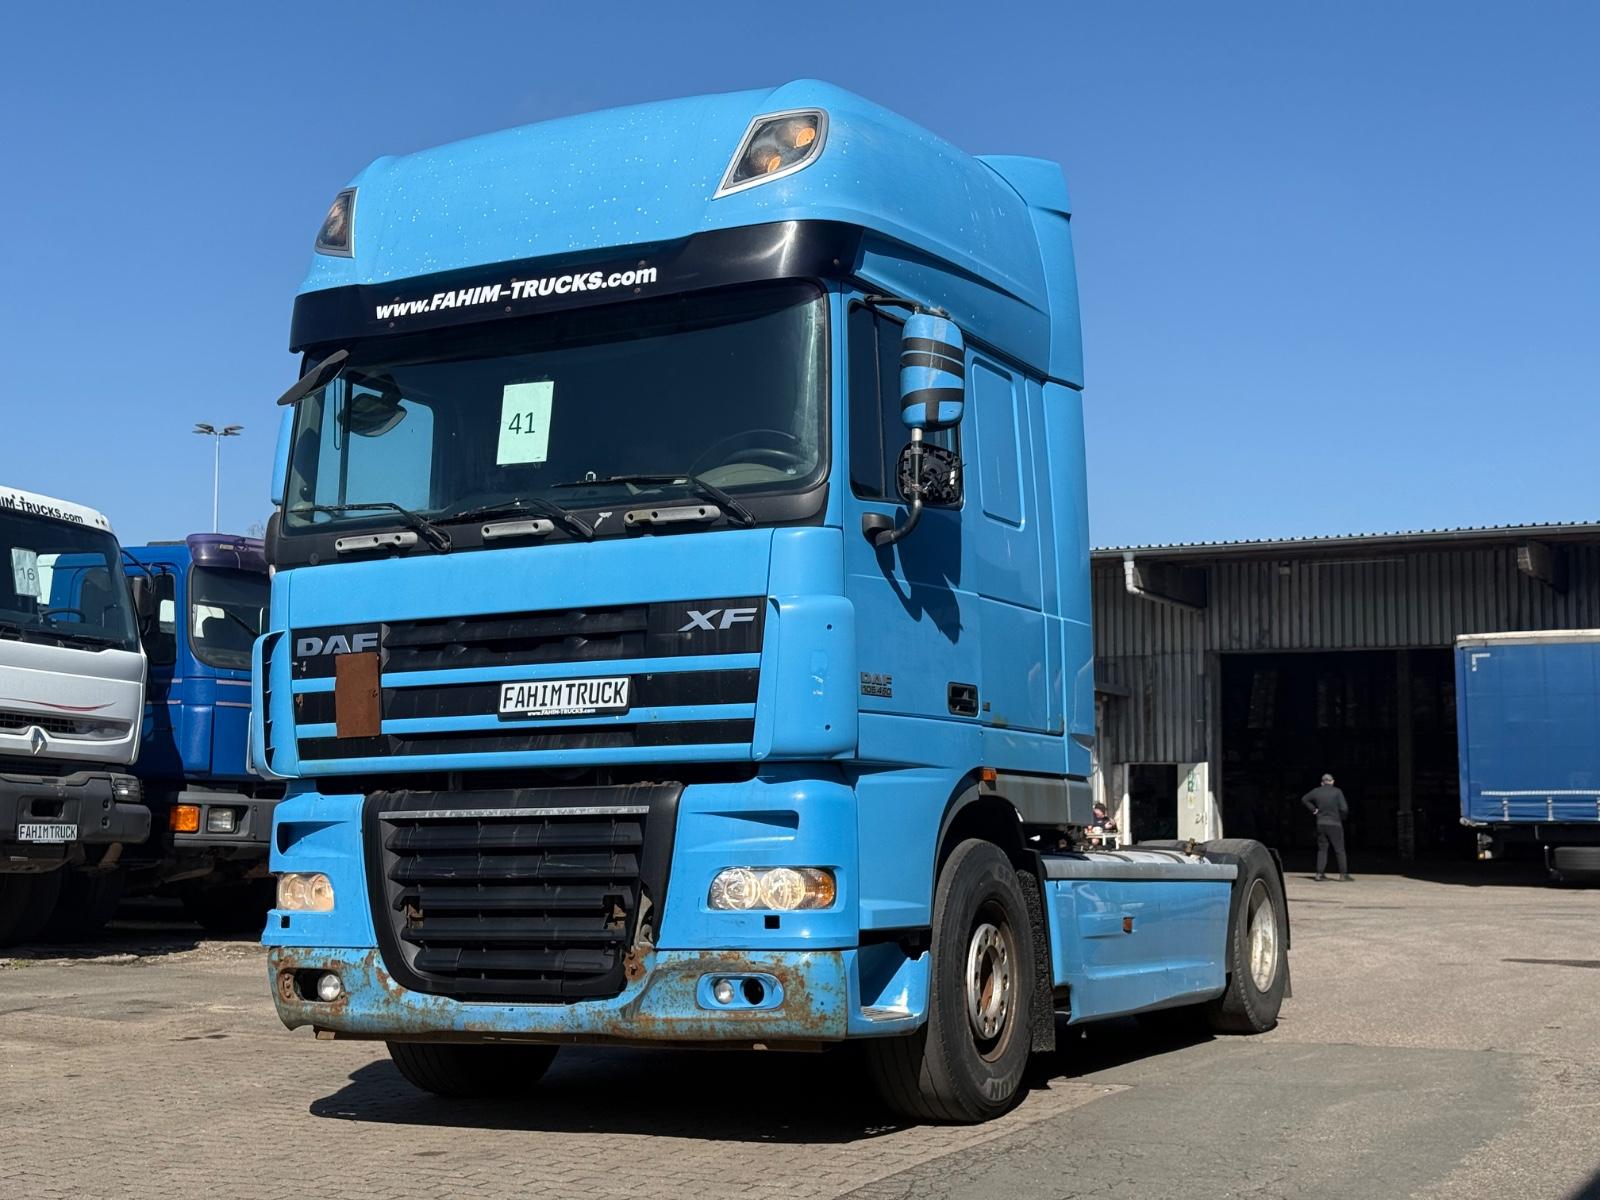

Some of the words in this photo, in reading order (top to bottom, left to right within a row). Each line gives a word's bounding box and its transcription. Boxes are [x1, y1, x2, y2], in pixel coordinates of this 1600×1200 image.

[376, 267, 657, 320] www.FAHIM-TRUCKS.com
[508, 411, 536, 435] 41
[0, 496, 84, 524] IM-TRUCKS.com
[20, 567, 35, 581] 16
[677, 607, 758, 632] XF
[297, 632, 379, 657] DAF
[860, 671, 893, 686] DAF
[503, 681, 626, 709] FAHIMTRUCK
[20, 825, 76, 839] FAHIMTRUCK
